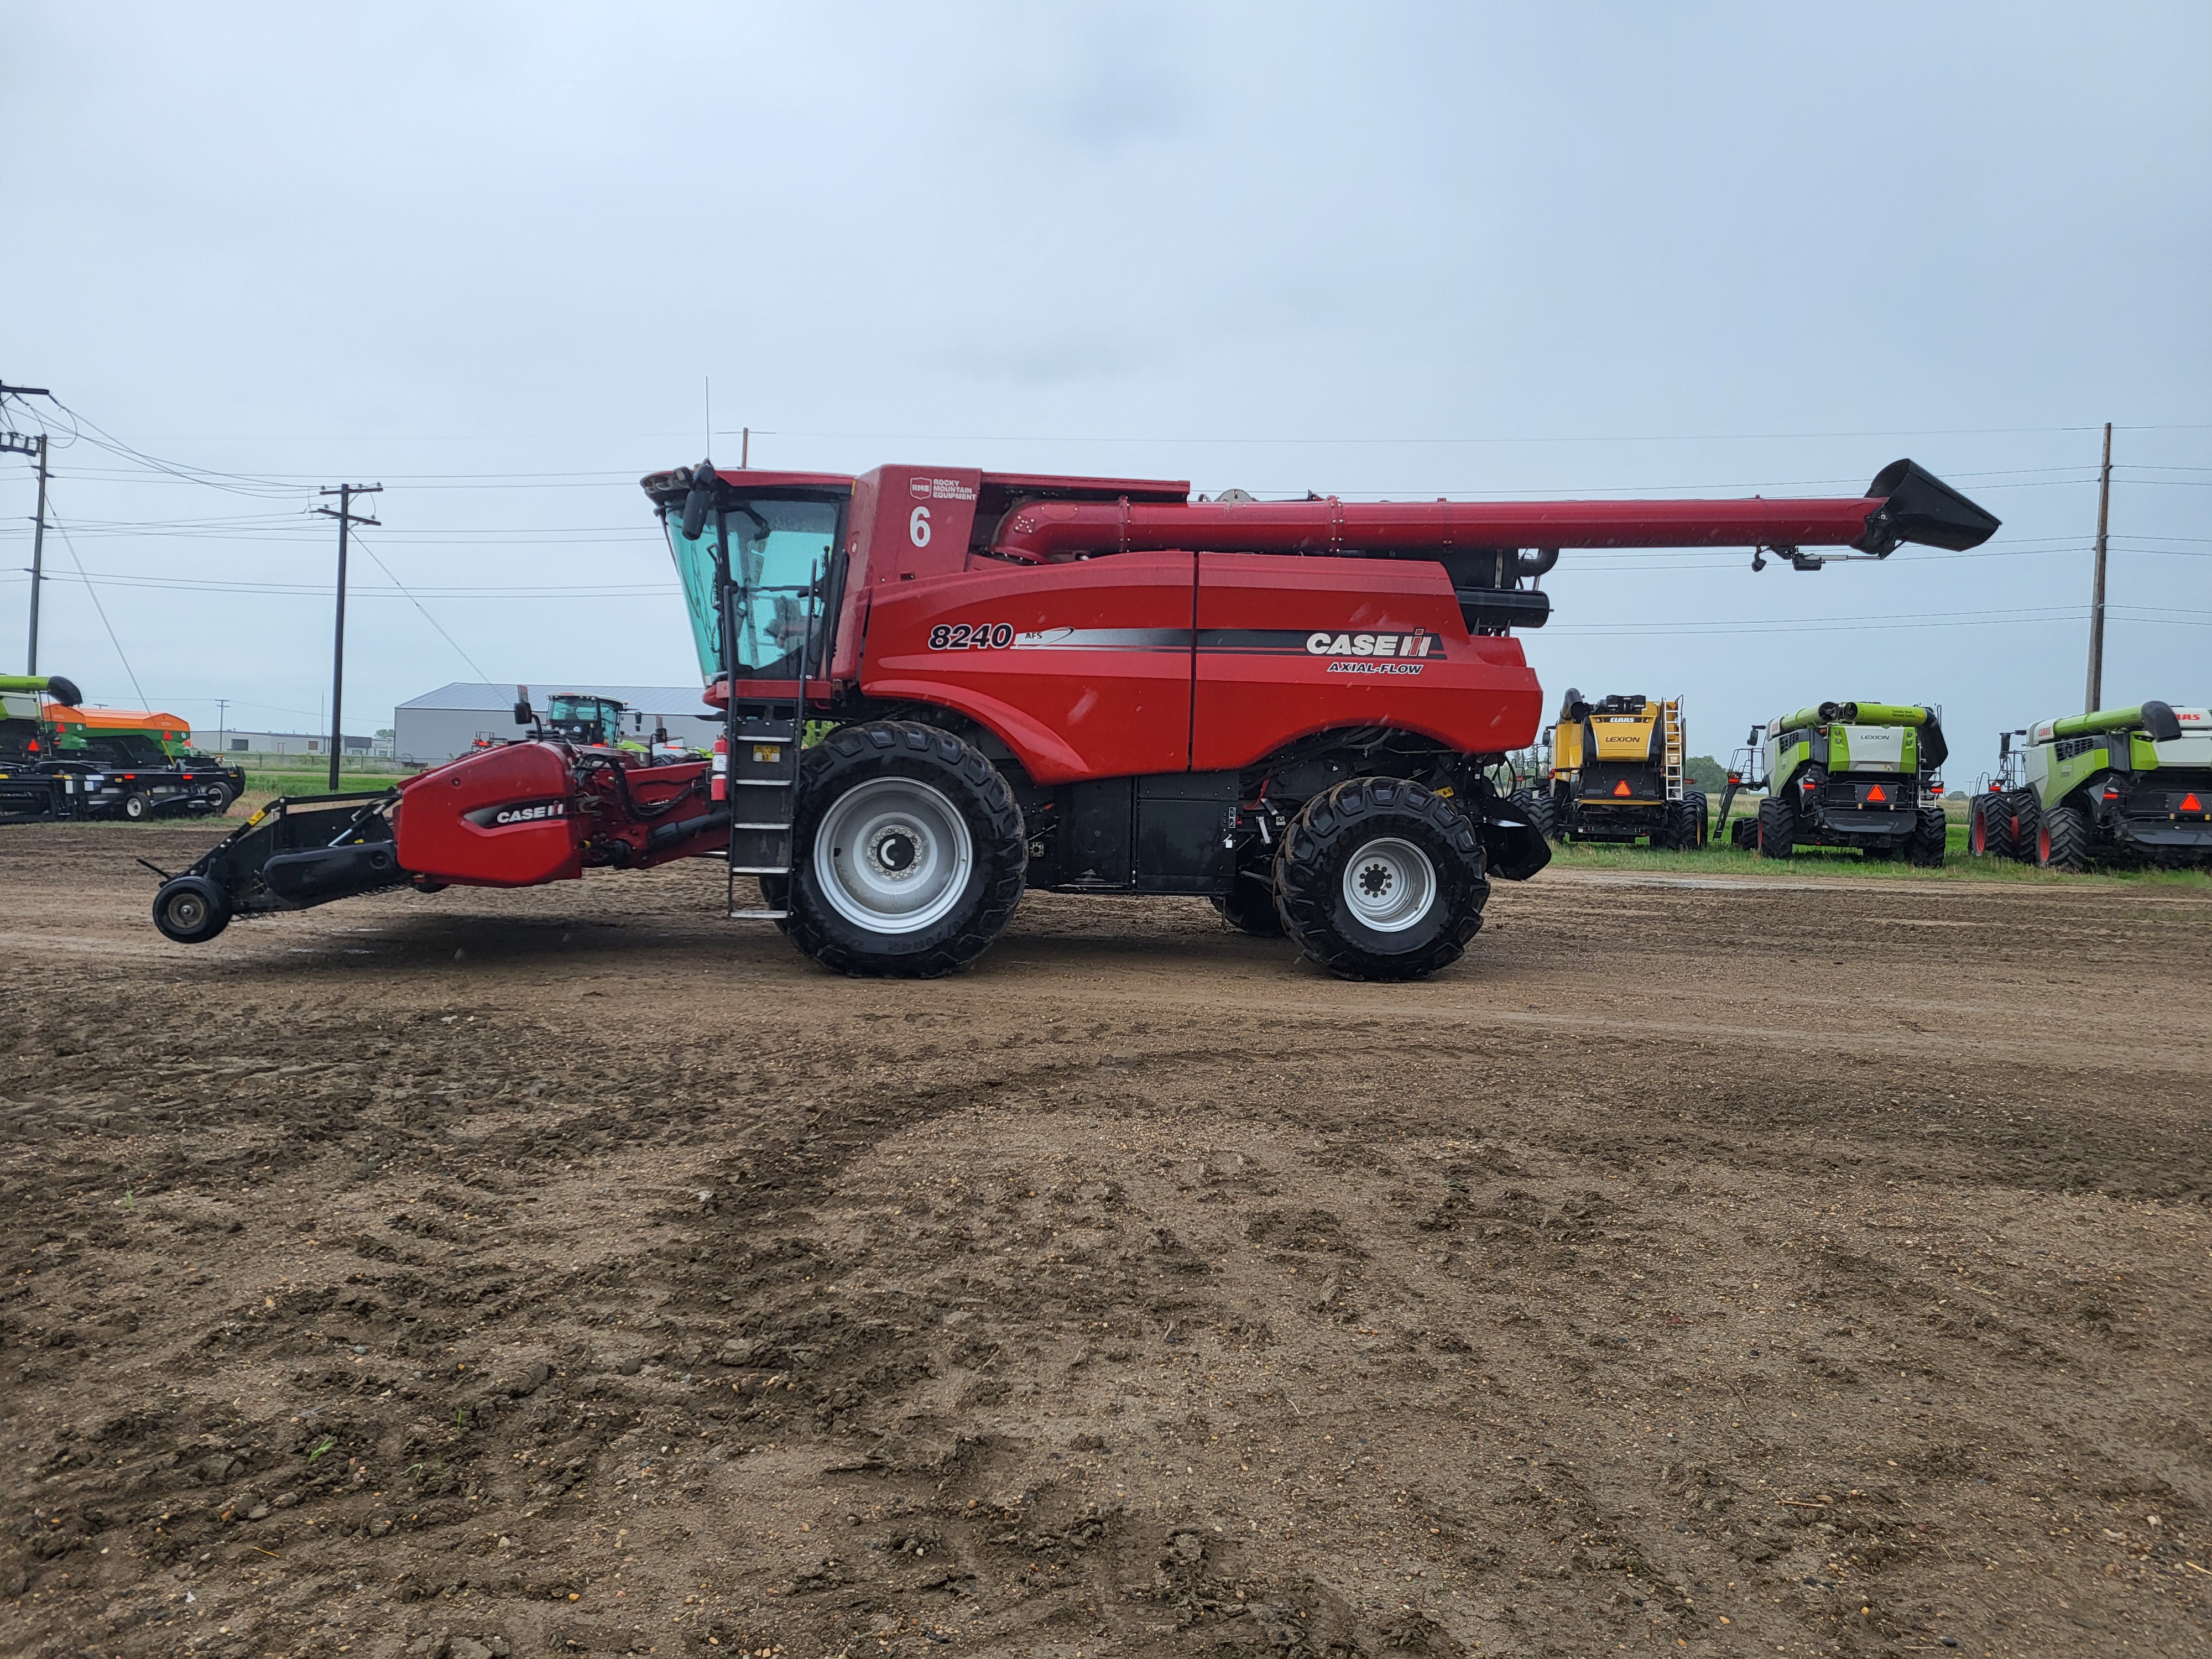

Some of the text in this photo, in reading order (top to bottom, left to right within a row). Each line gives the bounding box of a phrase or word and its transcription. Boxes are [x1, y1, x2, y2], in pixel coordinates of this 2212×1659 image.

[933, 486, 972, 494] MOUNTAIN
[933, 492, 977, 501] EQUIPMENT
[910, 505, 931, 547] 6
[928, 623, 1014, 650] 8240
[1306, 633, 1399, 656] CASE
[1327, 662, 1423, 675] AXIAL-FLOW
[497, 806, 546, 823] CASE
